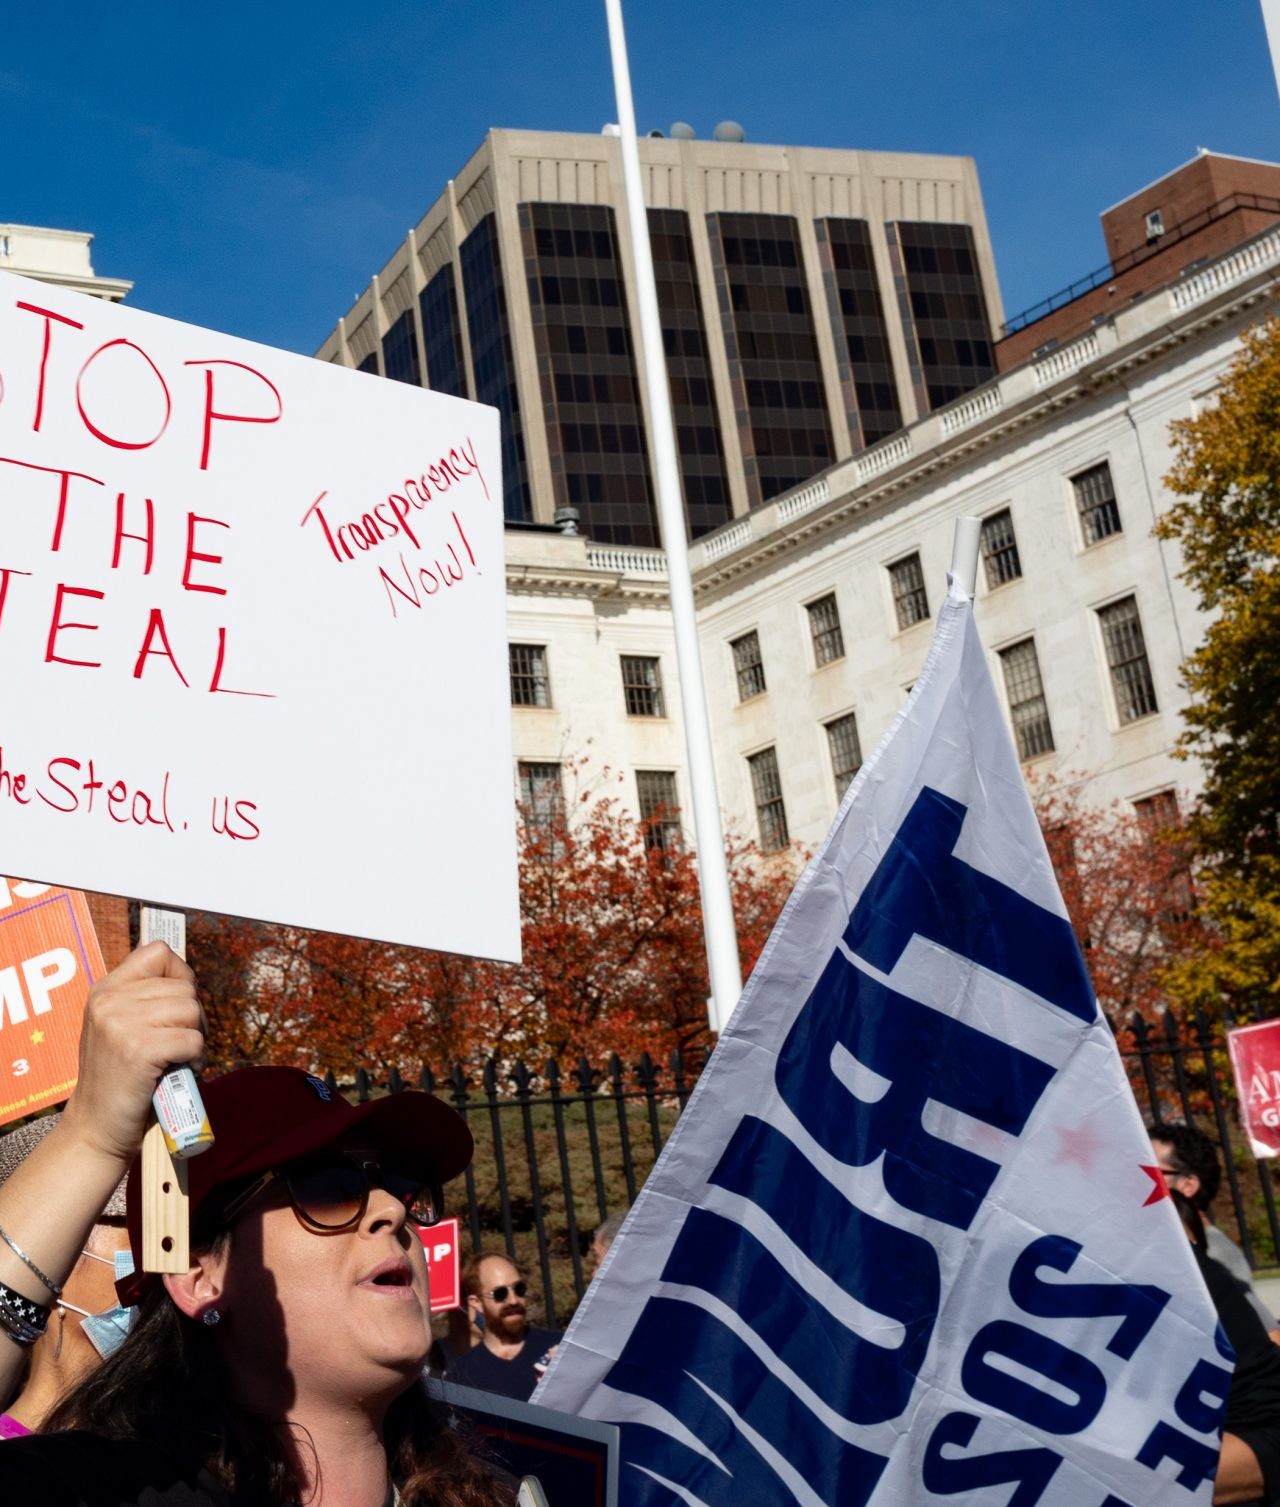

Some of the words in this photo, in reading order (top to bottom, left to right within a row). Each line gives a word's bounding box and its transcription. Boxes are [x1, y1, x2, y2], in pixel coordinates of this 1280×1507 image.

[301, 436, 490, 563] Transparency
[379, 511, 483, 618] Now!
[12, 1058, 30, 1076] 3
